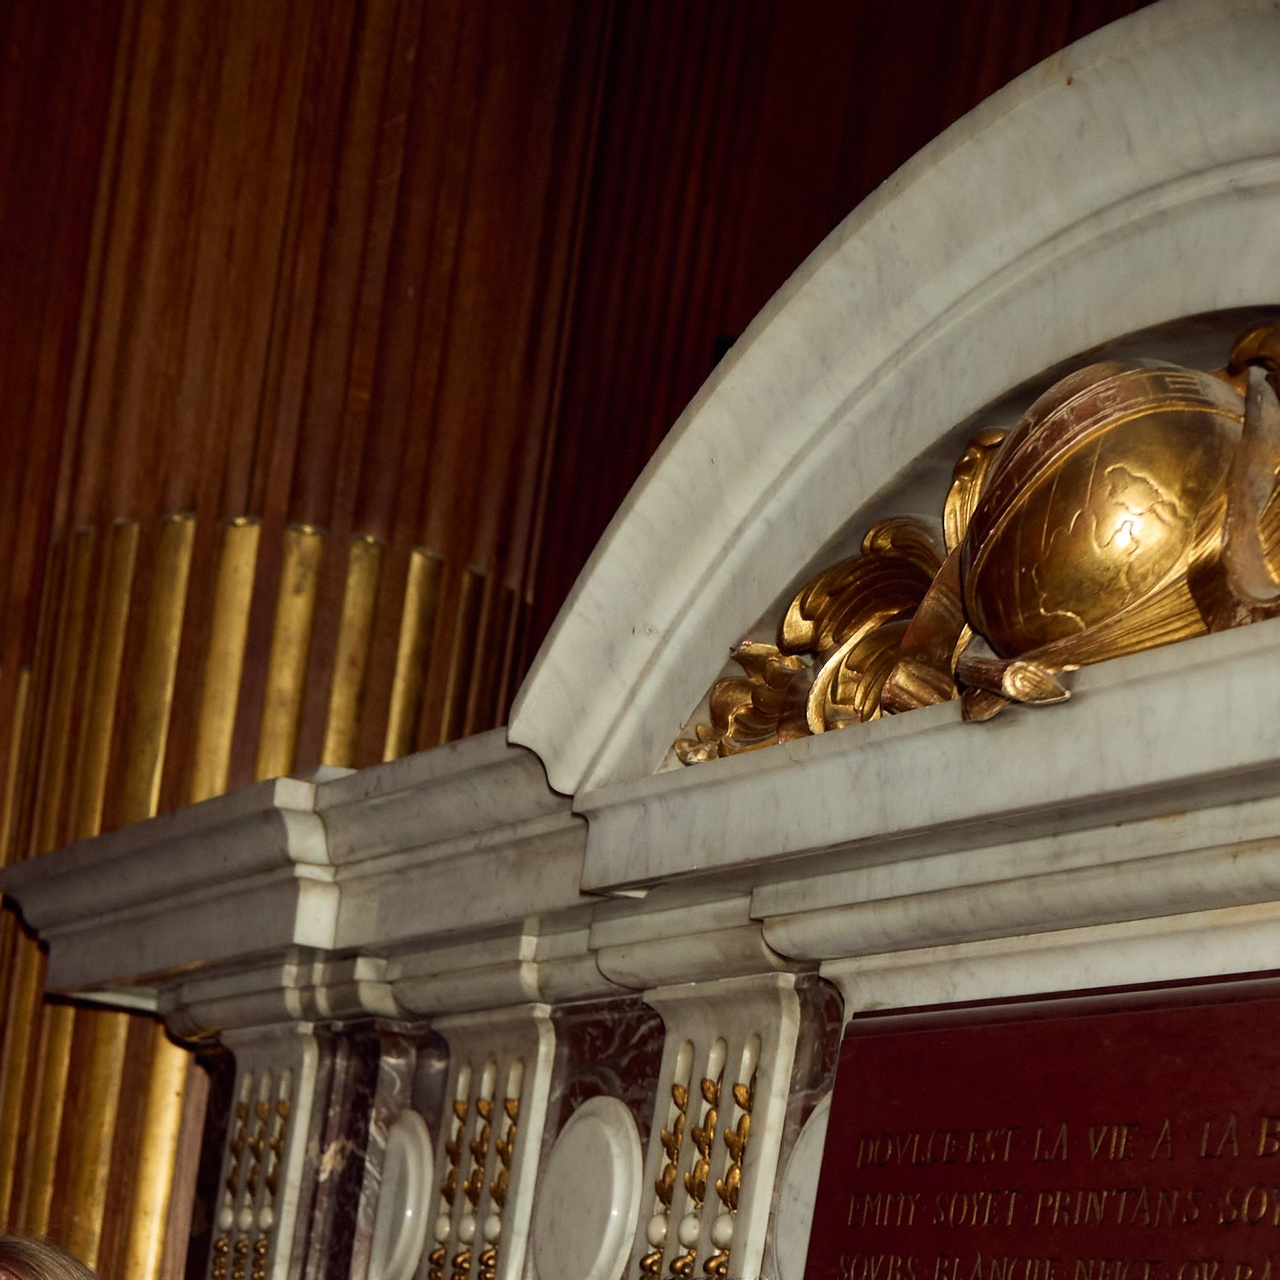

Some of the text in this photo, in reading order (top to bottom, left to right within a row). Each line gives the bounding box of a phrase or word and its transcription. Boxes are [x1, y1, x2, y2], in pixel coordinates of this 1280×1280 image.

[1032, 1122, 1069, 1163] LA
[1088, 1121, 1140, 1163] VIE
[1199, 1113, 1241, 1158] LA
[846, 1191, 922, 1228] EMMY
[1032, 1185, 1203, 1230] PRINTANS
